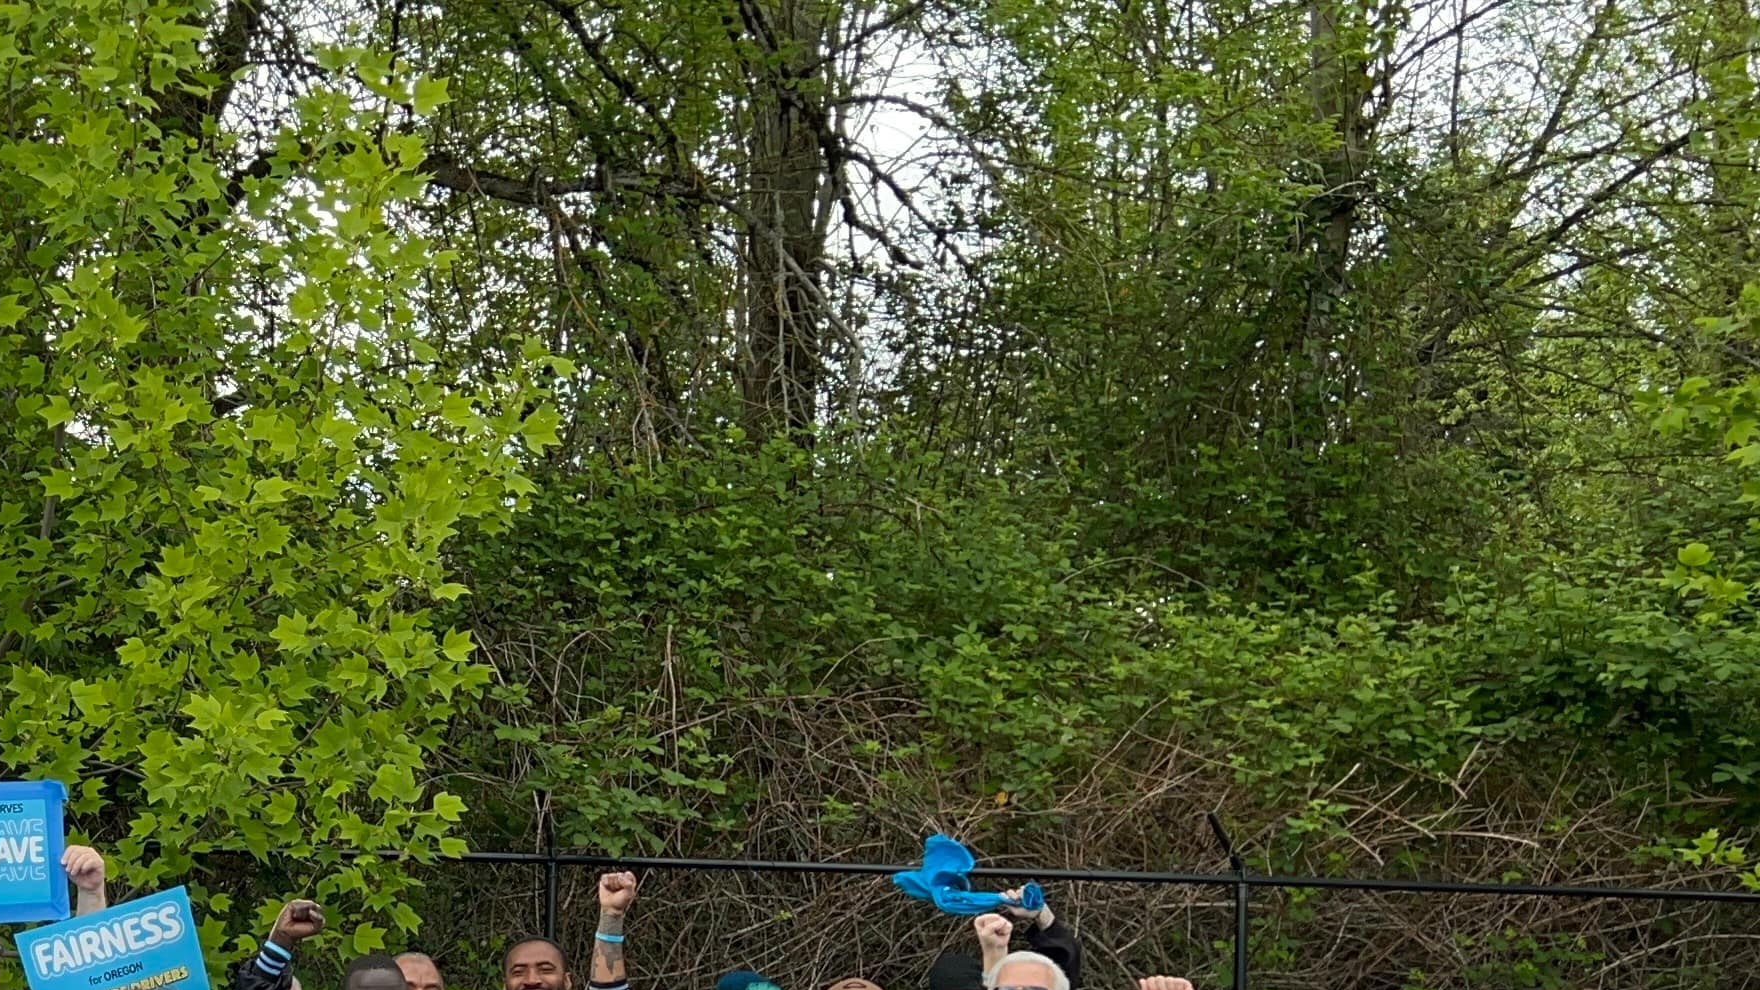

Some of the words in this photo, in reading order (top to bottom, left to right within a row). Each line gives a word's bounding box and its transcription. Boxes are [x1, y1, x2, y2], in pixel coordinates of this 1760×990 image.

[35, 906, 181, 975] FAIRNESS
[89, 975, 102, 985] for
[104, 961, 143, 981] OREGON
